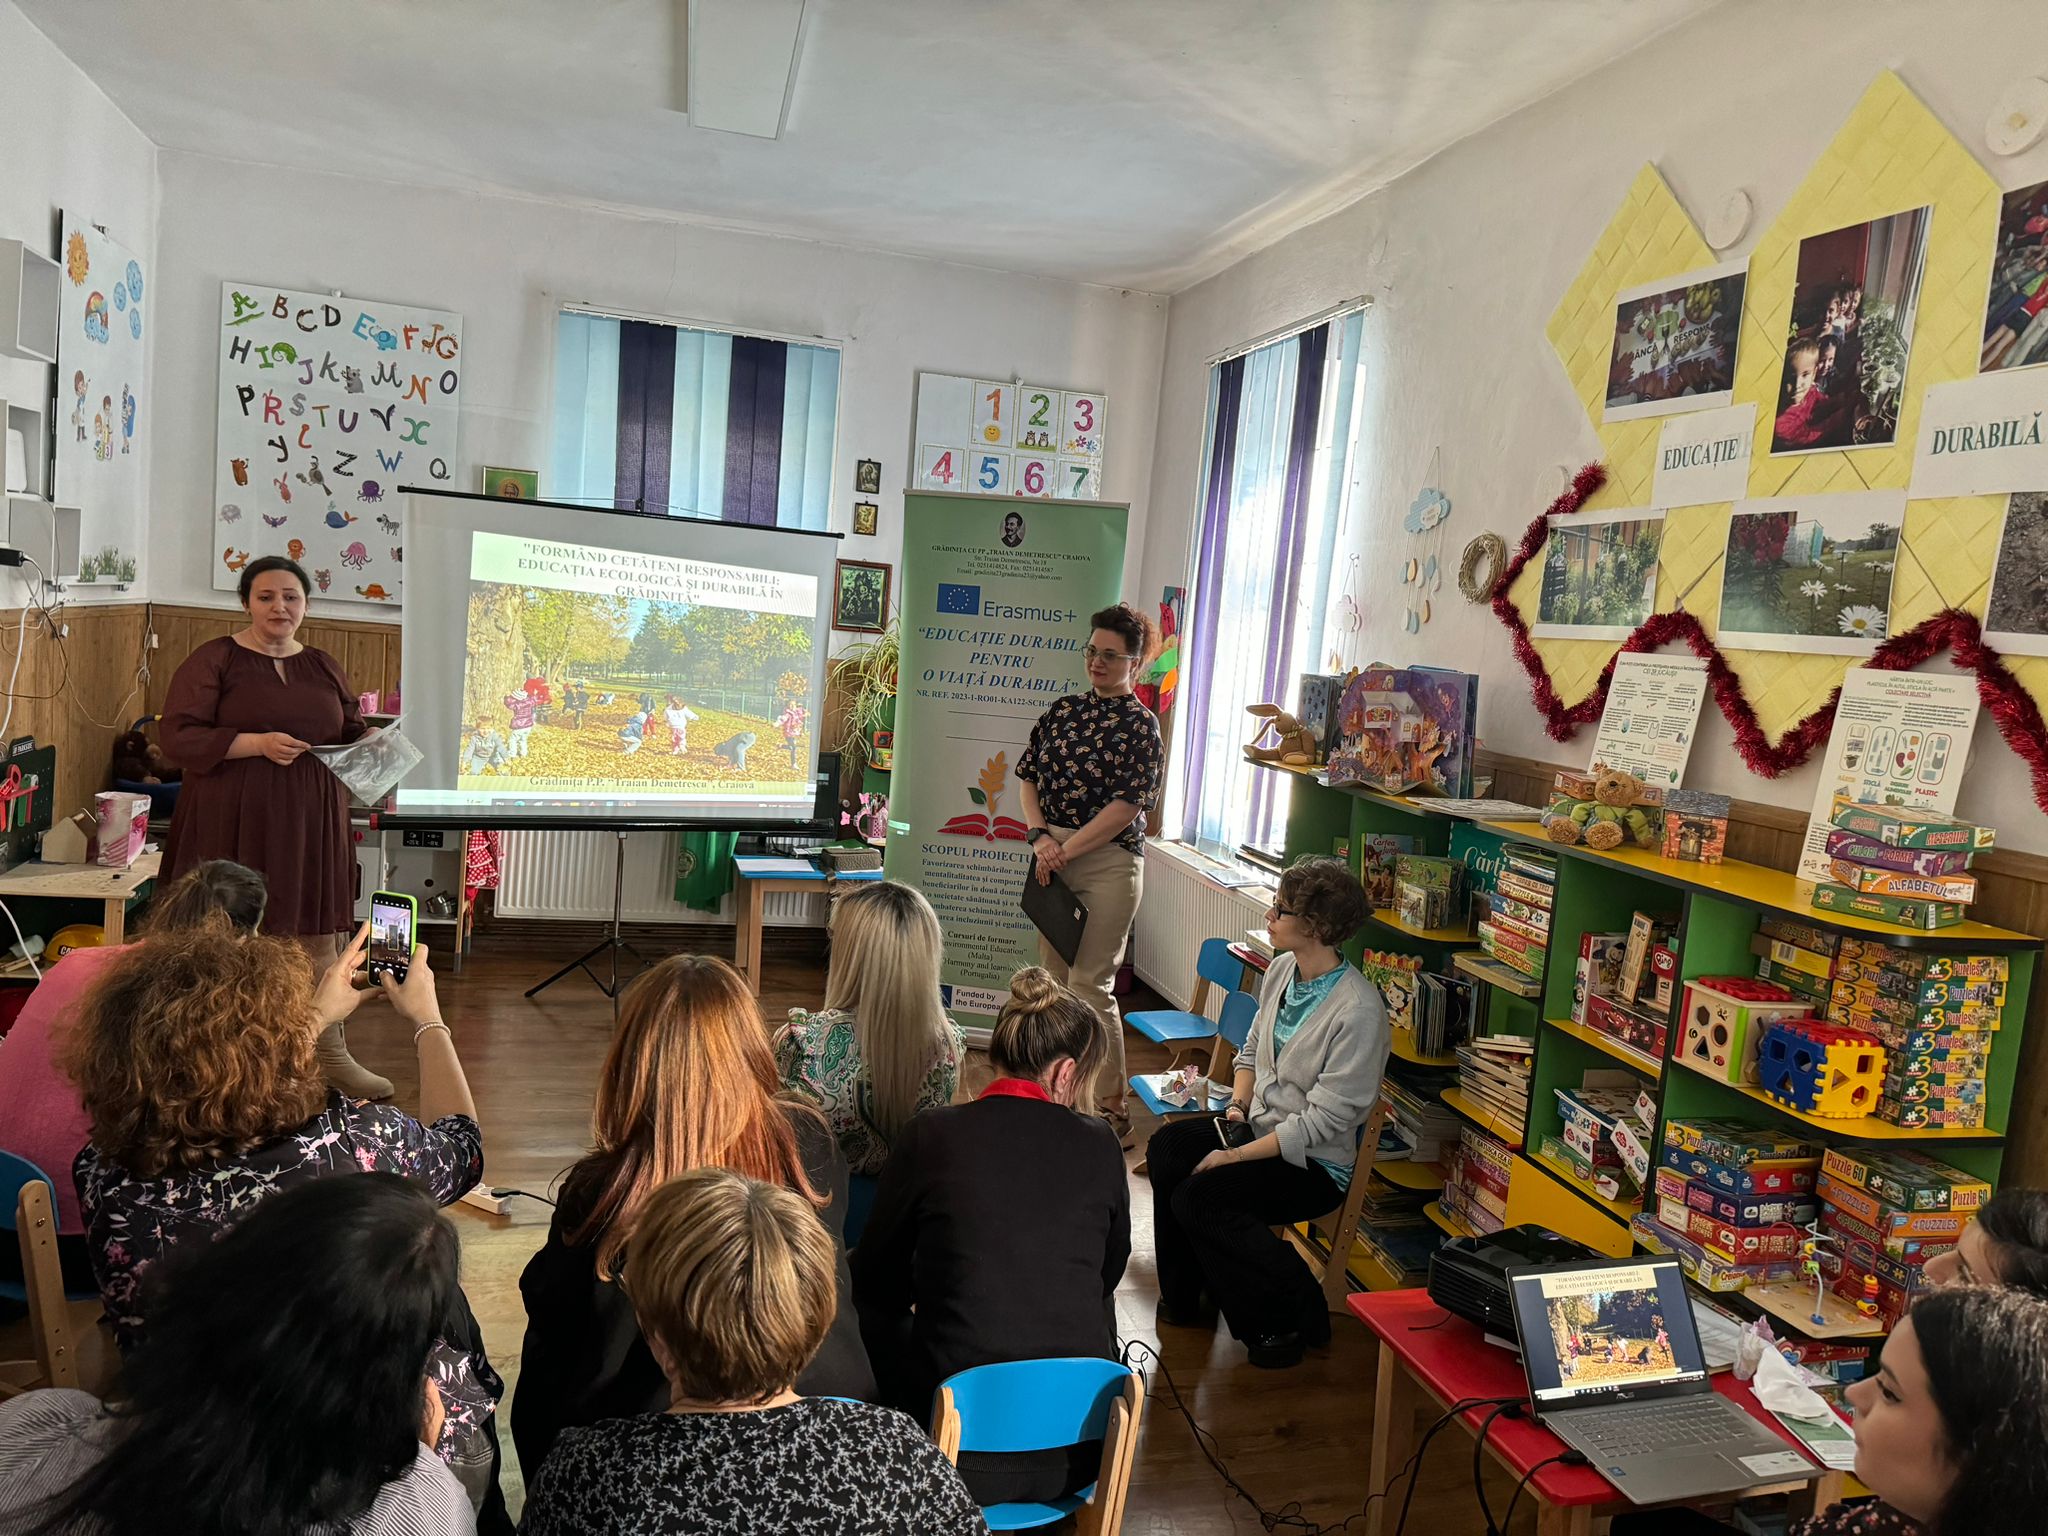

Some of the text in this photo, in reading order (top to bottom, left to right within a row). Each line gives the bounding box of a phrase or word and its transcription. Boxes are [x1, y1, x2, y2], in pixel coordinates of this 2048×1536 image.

[231, 291, 458, 359] A B C D E F G
[1673, 323, 1711, 344] RESPONS
[229, 336, 252, 364] H
[254, 346, 274, 368] I
[298, 359, 313, 385] J
[371, 361, 402, 388] M
[402, 374, 432, 405] N
[439, 370, 457, 394] O
[236, 384, 431, 445] P R S T U V X
[986, 388, 1093, 432] 1 2 3
[1930, 411, 2042, 455] DURABILĂ
[1663, 438, 1738, 471] EDUCAȚIE
[333, 449, 451, 480] Z W Q
[931, 451, 1089, 498] 4 5 6 7
[984, 601, 1077, 622] Erasmus+
[1009, 635, 1082, 652] DURABIL
[970, 652, 1035, 668] PENTRU
[923, 669, 934, 681] O
[939, 671, 986, 687] VIAȚĂ
[916, 689, 930, 697] NR.
[932, 691, 949, 699] REF.
[1915, 788, 1938, 797] PLASTIC
[922, 843, 970, 857] SCOPUL
[1373, 838, 1396, 847] Cartea
[922, 859, 964, 869] Favorizarea
[966, 864, 1012, 875] schimbărilor
[922, 880, 969, 891] beneficiarilor
[980, 886, 997, 894] două
[990, 879, 1024, 887] comporta
[1888, 879, 1949, 897] ALFABETUL
[934, 892, 964, 901] societate
[966, 895, 1000, 906] sănătoasă
[969, 906, 1014, 917] schimbărilor
[944, 941, 988, 951] nvironmental
[948, 931, 976, 940] Cursuri
[988, 936, 1016, 945] formare
[968, 952, 992, 961] (Malta)
[977, 961, 1013, 972] and learnin
[1849, 961, 1861, 982] 3
[1938, 958, 1981, 982] 3 Puzzles
[956, 989, 996, 1001] Funded by
[1844, 984, 1856, 1006] 3
[1934, 983, 1977, 1006] 3 Puzzles
[970, 1000, 1001, 1010] Europea
[1931, 1007, 1973, 1031] 3 Puzzles
[1922, 1031, 1963, 1055] 3 Puzzles
[1917, 1056, 1958, 1079] 3 Puzzles
[1915, 1080, 1957, 1103] 3 Puzzles
[1913, 1105, 1956, 1129] 3 Puzzles
[1674, 1126, 1711, 1153] 3 Puzzles
[1826, 1152, 1864, 1181] Puzzle 60
[1952, 1189, 1988, 1206] Puzzle 60
[1877, 1258, 1890, 1273] 60
